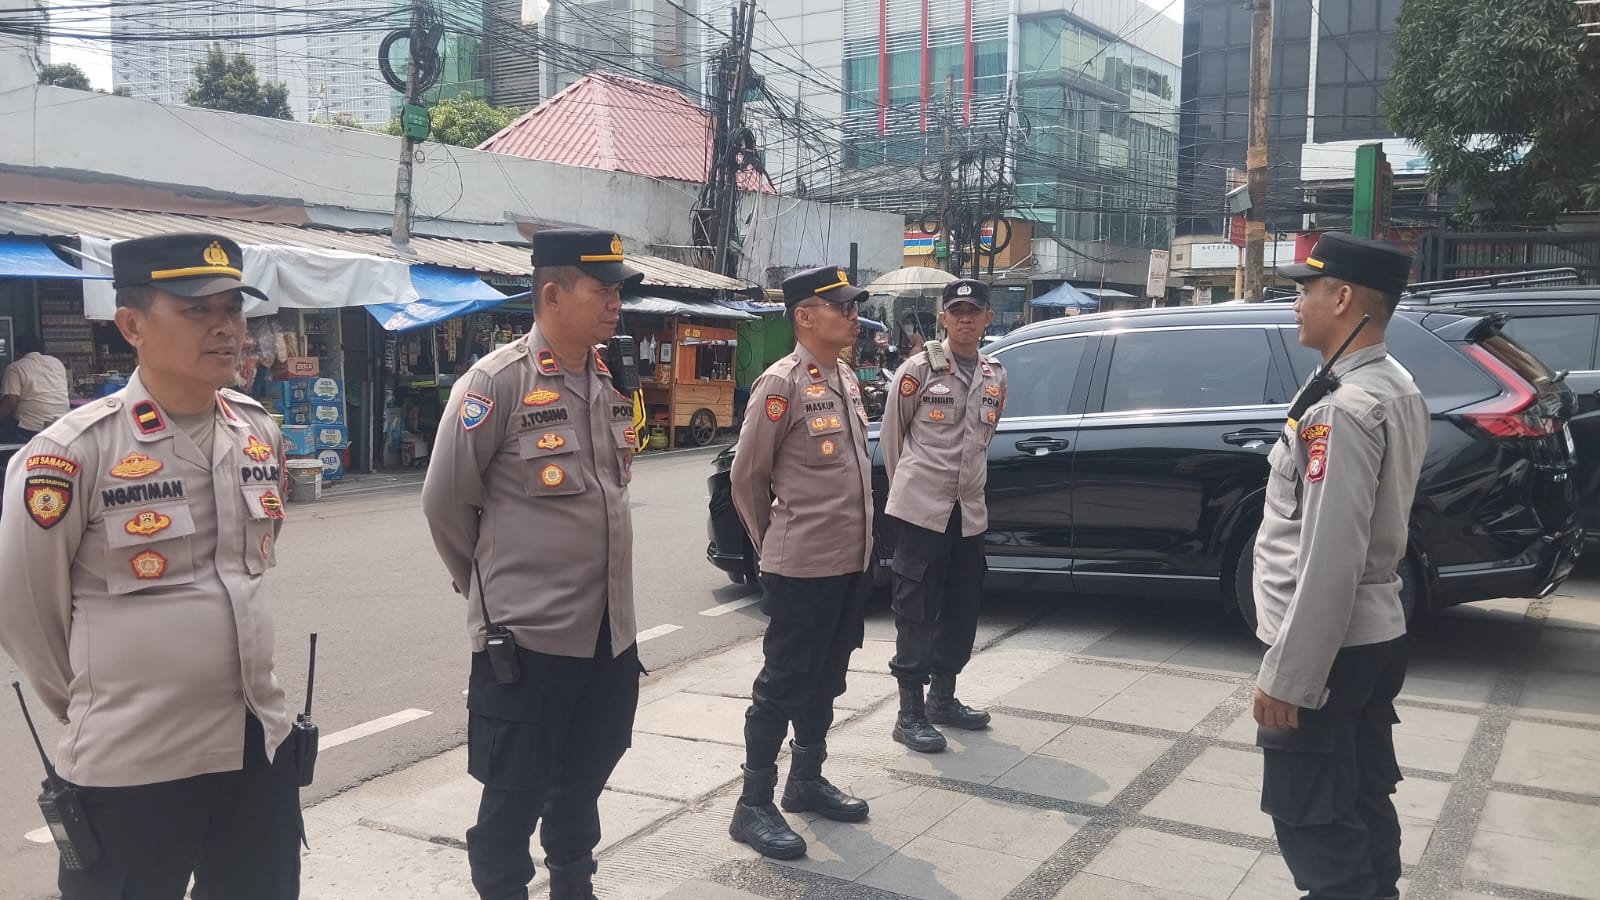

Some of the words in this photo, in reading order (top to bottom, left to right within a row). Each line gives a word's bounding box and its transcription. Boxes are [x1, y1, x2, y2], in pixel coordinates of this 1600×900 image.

[805, 401, 835, 413] MASKUR
[521, 408, 568, 427] J.TOBING
[28, 457, 40, 467] SAT
[40, 457, 74, 473] SAMAPTA
[102, 480, 184, 507] NGATIMAN
